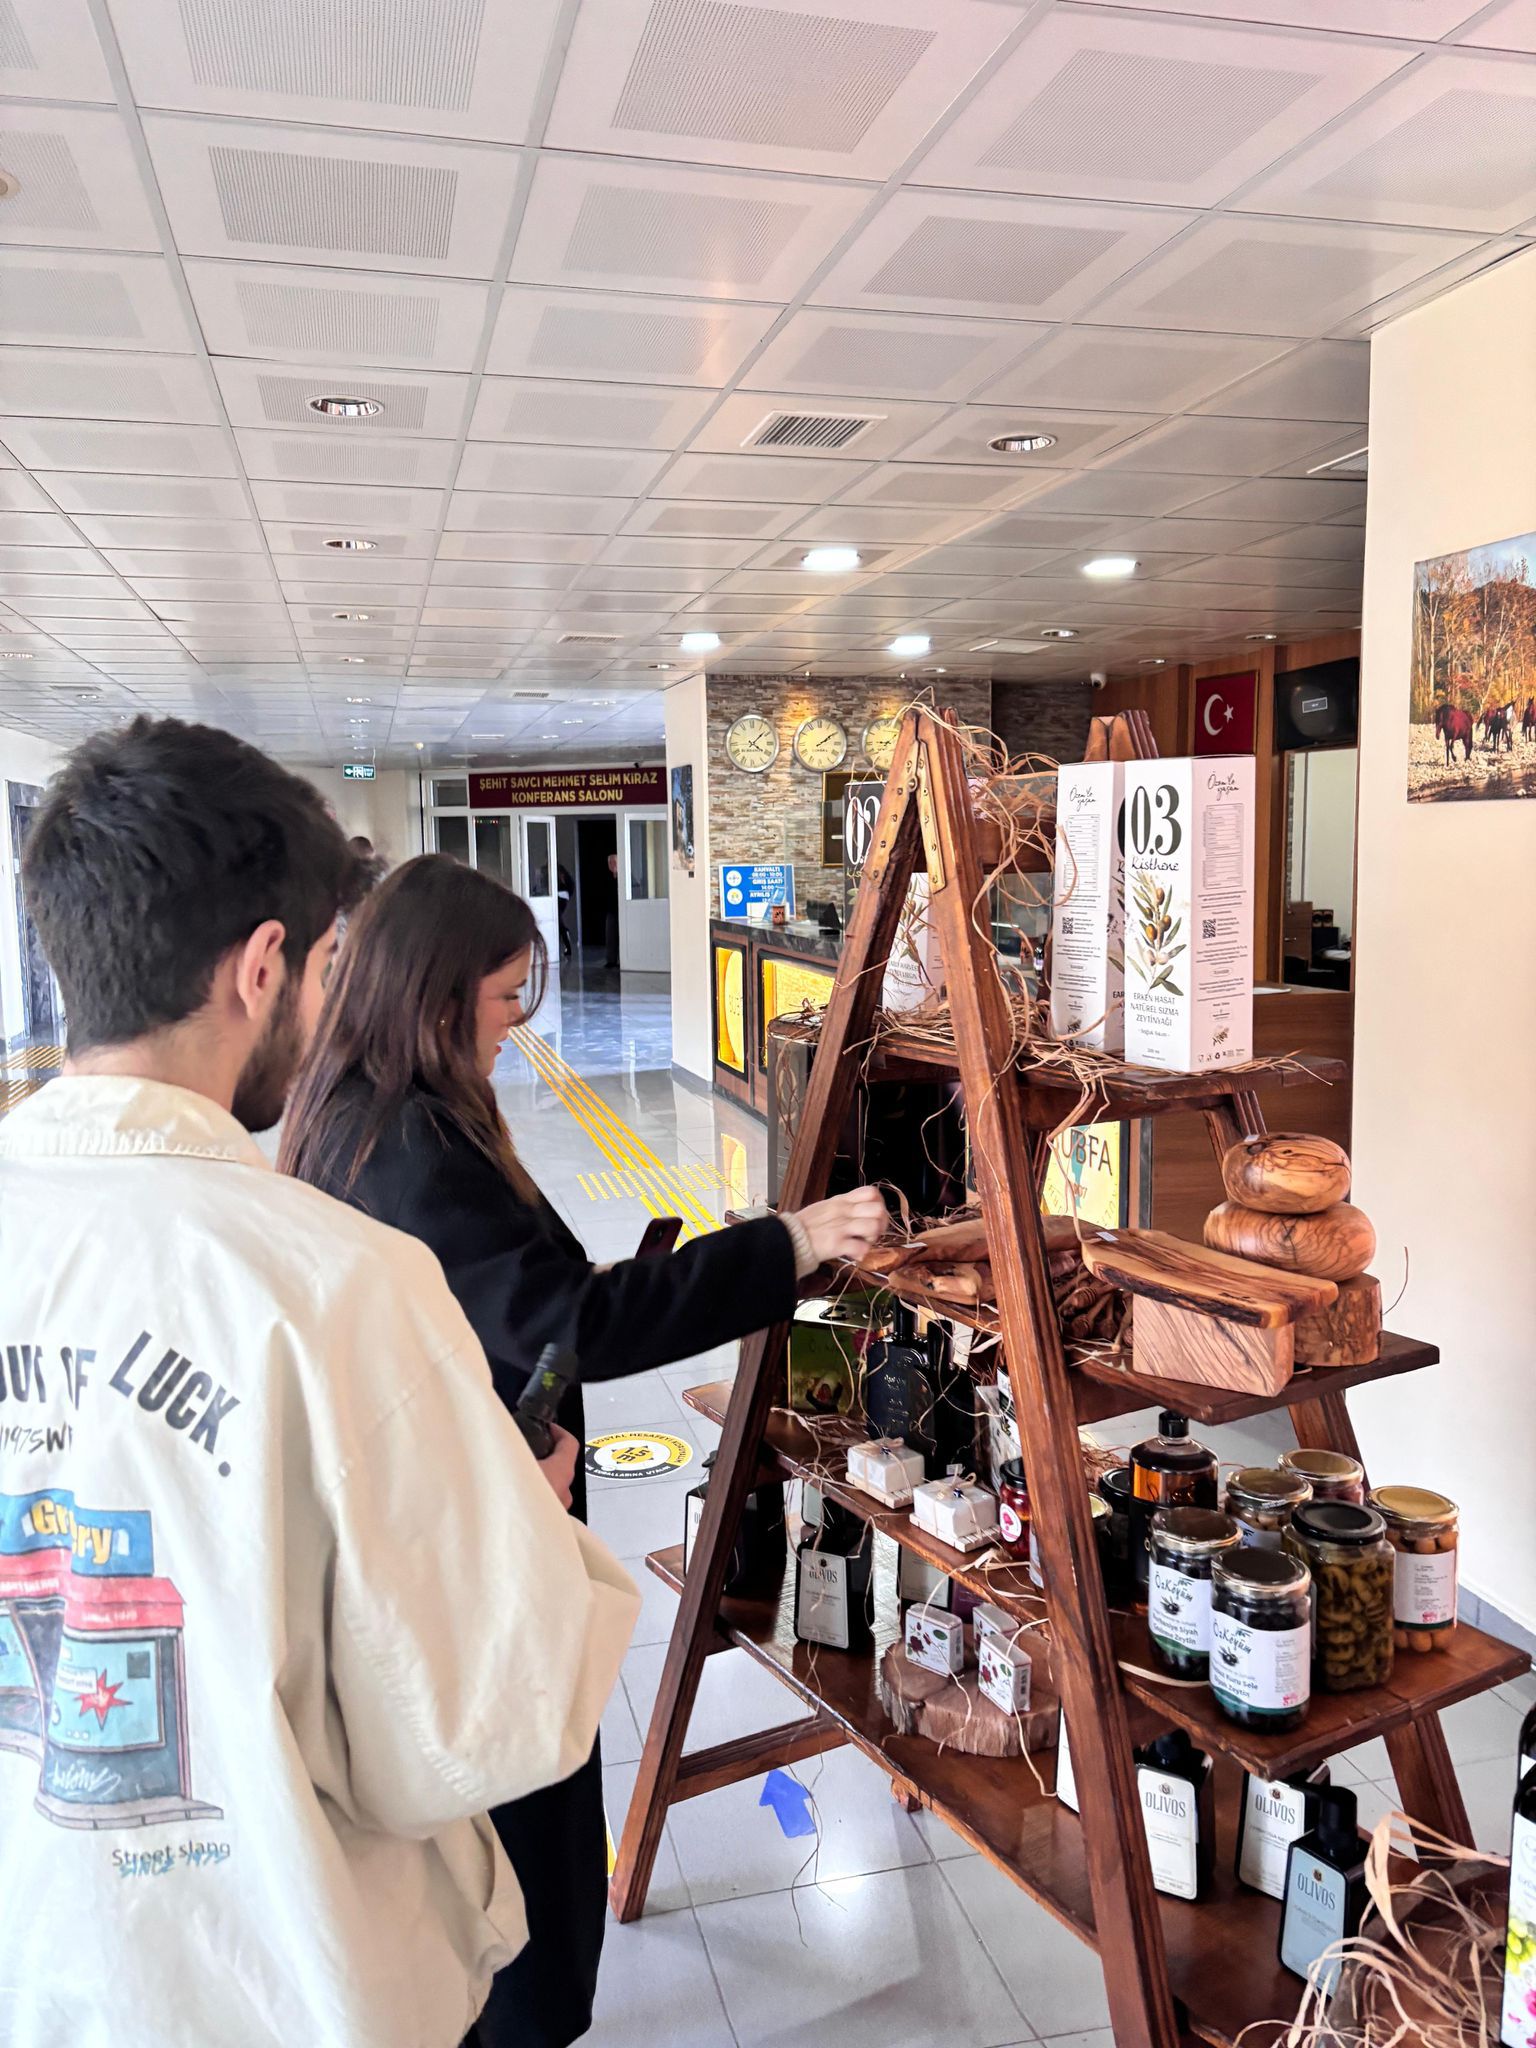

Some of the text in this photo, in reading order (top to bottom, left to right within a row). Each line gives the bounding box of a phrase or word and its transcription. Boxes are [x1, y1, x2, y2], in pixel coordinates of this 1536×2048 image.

[510, 776, 541, 789] SAVCI
[543, 774, 587, 788] MEHMET
[589, 773, 621, 786] SELİM
[622, 771, 658, 785] KİRAZ
[511, 789, 623, 804] KONFERANS SALONU
[1131, 784, 1182, 856] 0.3
[624, 1446, 651, 1457] 1.5
[1145, 1791, 1187, 1818] OLIVOS
[1255, 1793, 1296, 1825] OLIVOS
[1297, 1872, 1336, 1911] OLIVOS
